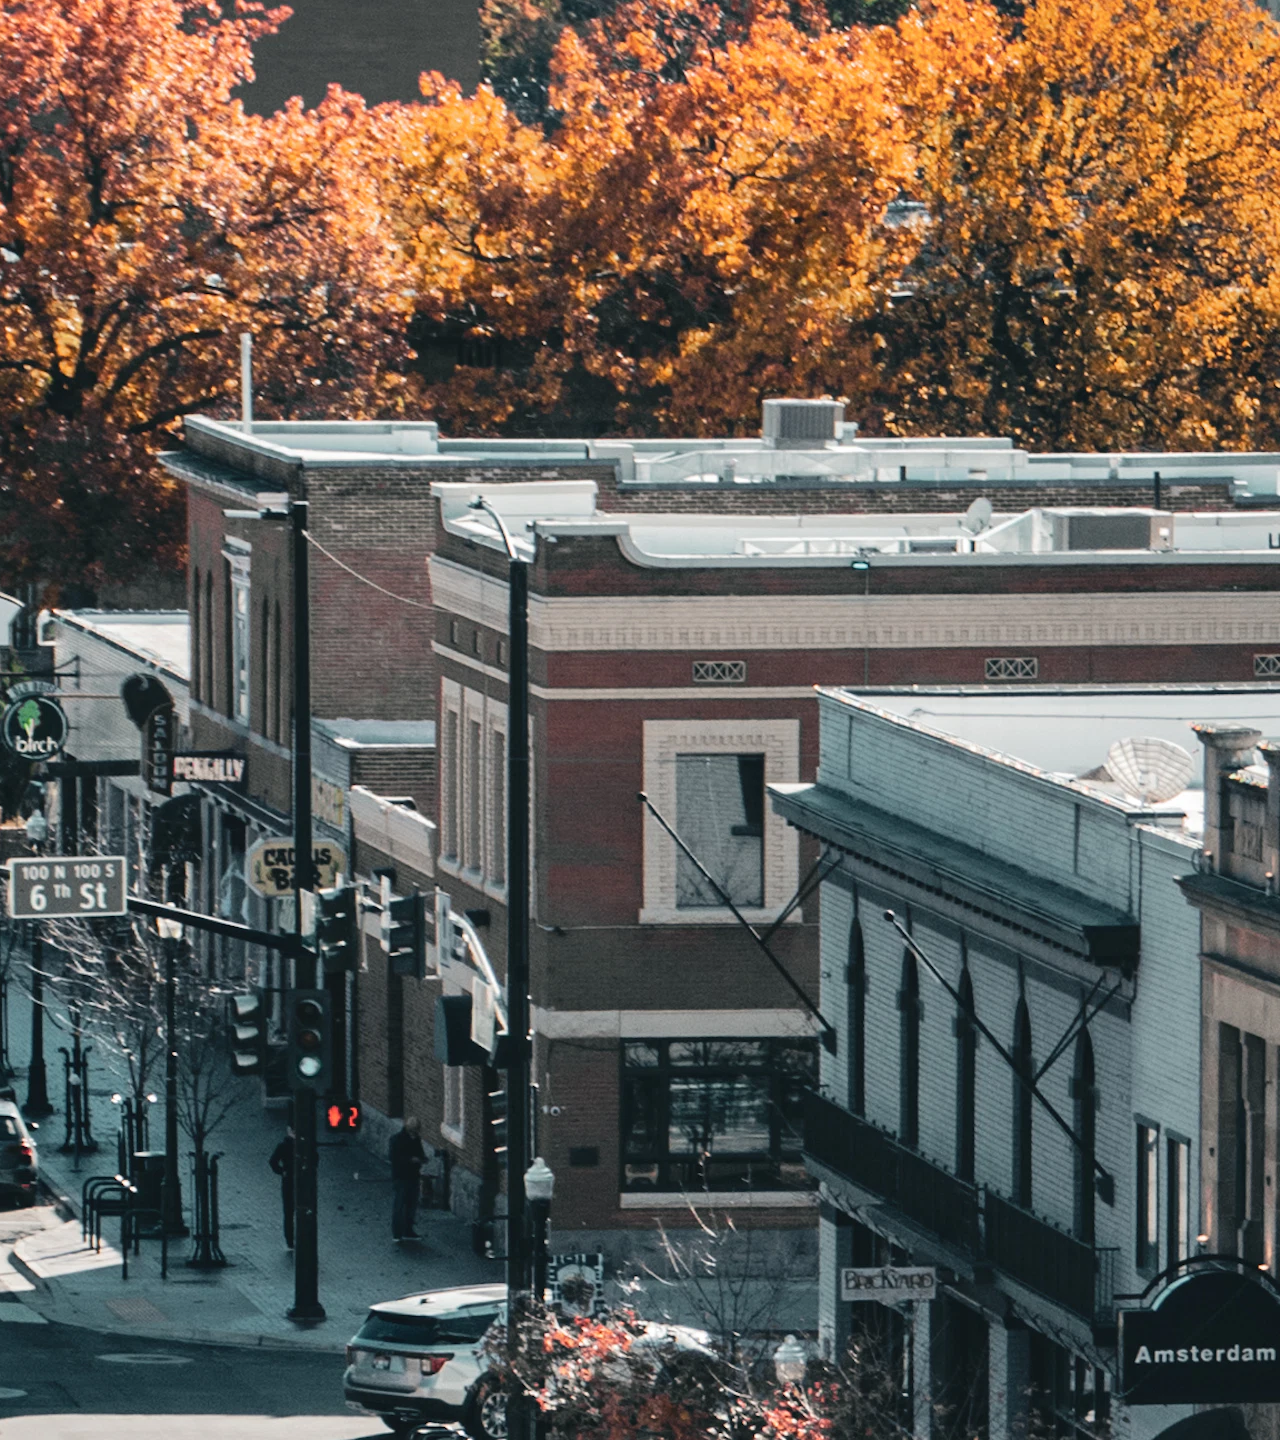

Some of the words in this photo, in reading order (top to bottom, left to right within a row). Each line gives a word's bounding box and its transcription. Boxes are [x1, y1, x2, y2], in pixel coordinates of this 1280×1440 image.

[15, 735, 58, 753] birch
[22, 865, 49, 880] 100
[55, 865, 66, 880] N
[74, 864, 101, 879] 100
[105, 863, 115, 878] S
[30, 884, 47, 911] 6
[53, 885, 72, 899] Th
[79, 882, 108, 910] St
[1134, 1344, 1277, 1364] Amsterdam
